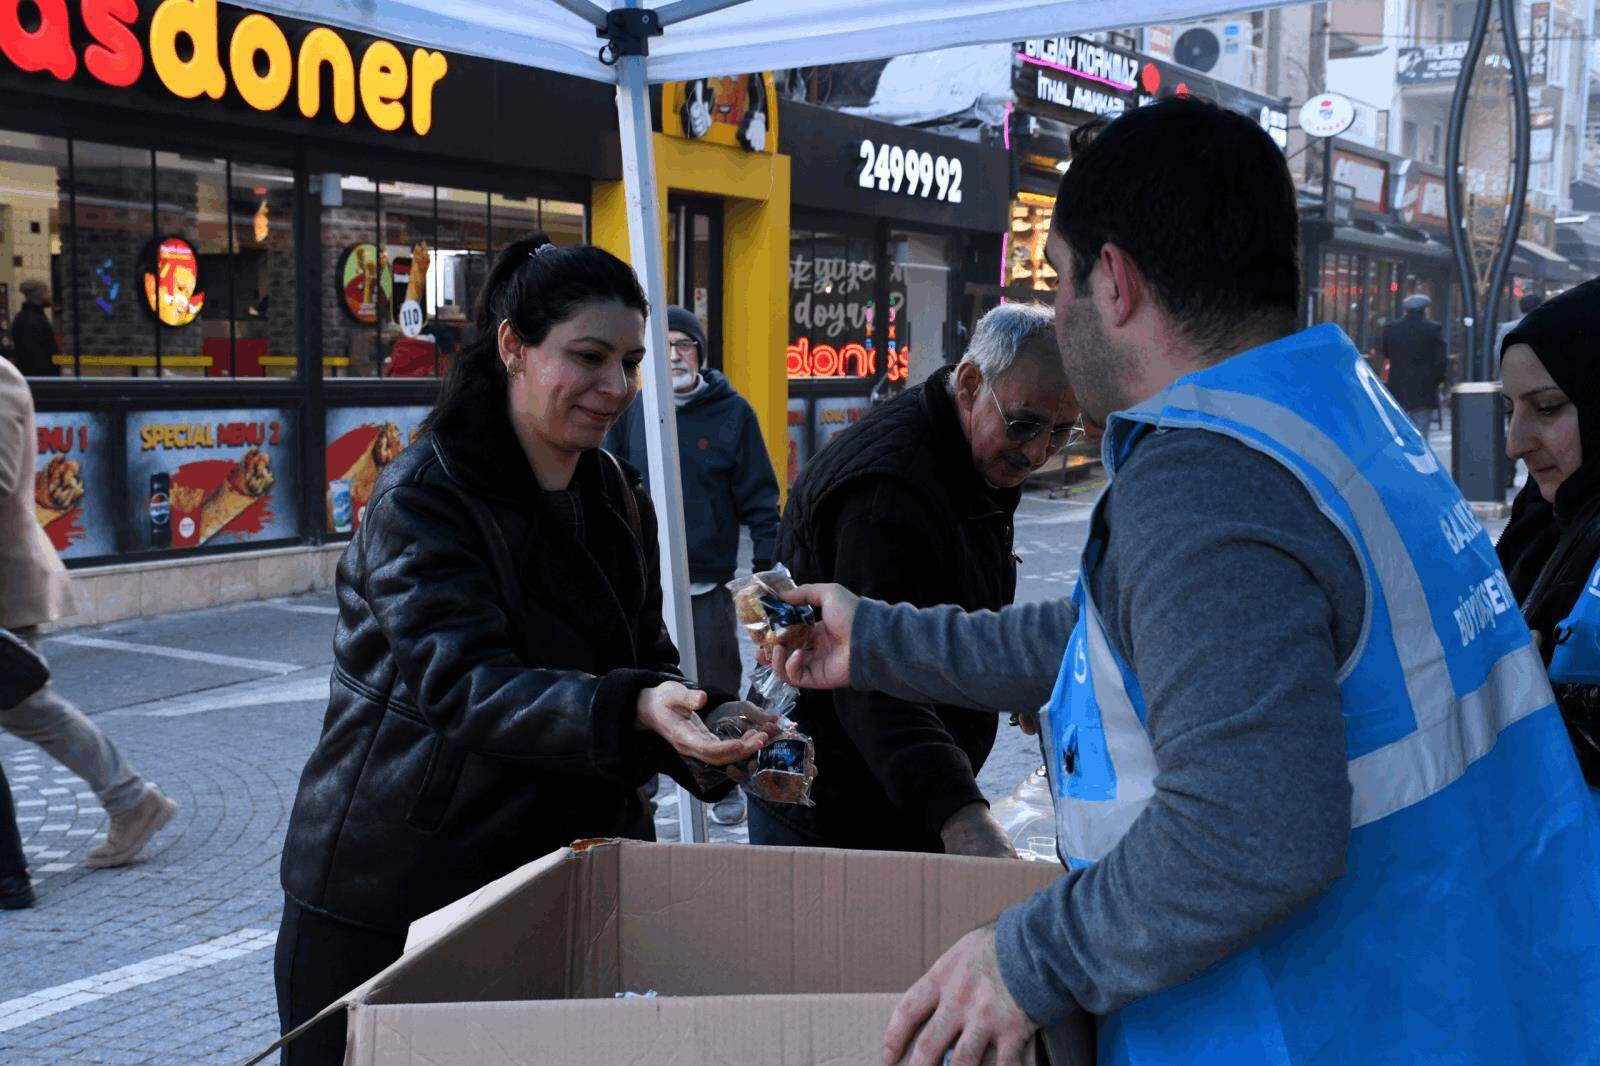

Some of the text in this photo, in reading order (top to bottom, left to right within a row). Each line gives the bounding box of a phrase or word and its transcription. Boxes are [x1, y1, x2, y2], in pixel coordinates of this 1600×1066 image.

[859, 139, 963, 203] 2499992
[403, 308, 419, 327] 110
[78, 426, 88, 453] 1
[140, 420, 281, 451] SPECIAL MENU 2
